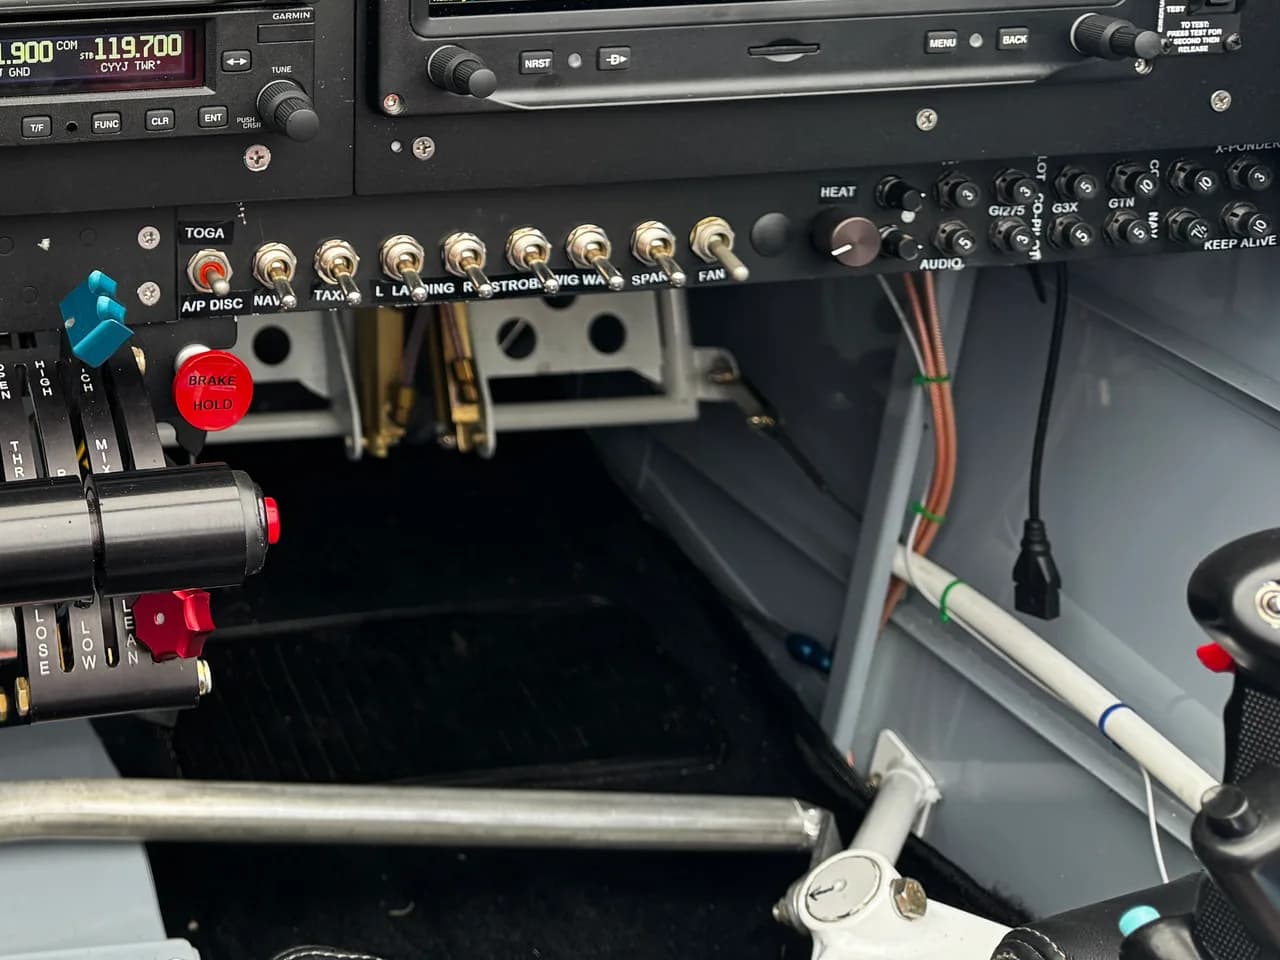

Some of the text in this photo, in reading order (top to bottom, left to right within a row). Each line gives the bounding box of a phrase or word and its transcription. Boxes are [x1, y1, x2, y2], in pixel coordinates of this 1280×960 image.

[272, 11, 311, 20] GARMIN
[95, 35, 182, 60] 119.700
[8, 67, 31, 78] GND
[271, 65, 293, 74] TUNE
[95, 119, 120, 130] FUNC
[151, 116, 169, 127] CLR
[204, 113, 223, 123] ENT
[30, 122, 45, 132] T/F
[821, 185, 856, 198] HEAT
[1052, 201, 1078, 214] G3X
[185, 227, 225, 239] TOGA
[1204, 235, 1277, 251] KEEP ALIVE
[920, 257, 962, 271] AUDIO
[698, 268, 725, 283] FAN
[182, 298, 243, 313] A/P DISC
[188, 373, 236, 387] BRAKE
[193, 398, 233, 411] HOLD
[81, 621, 96, 670] LOW
